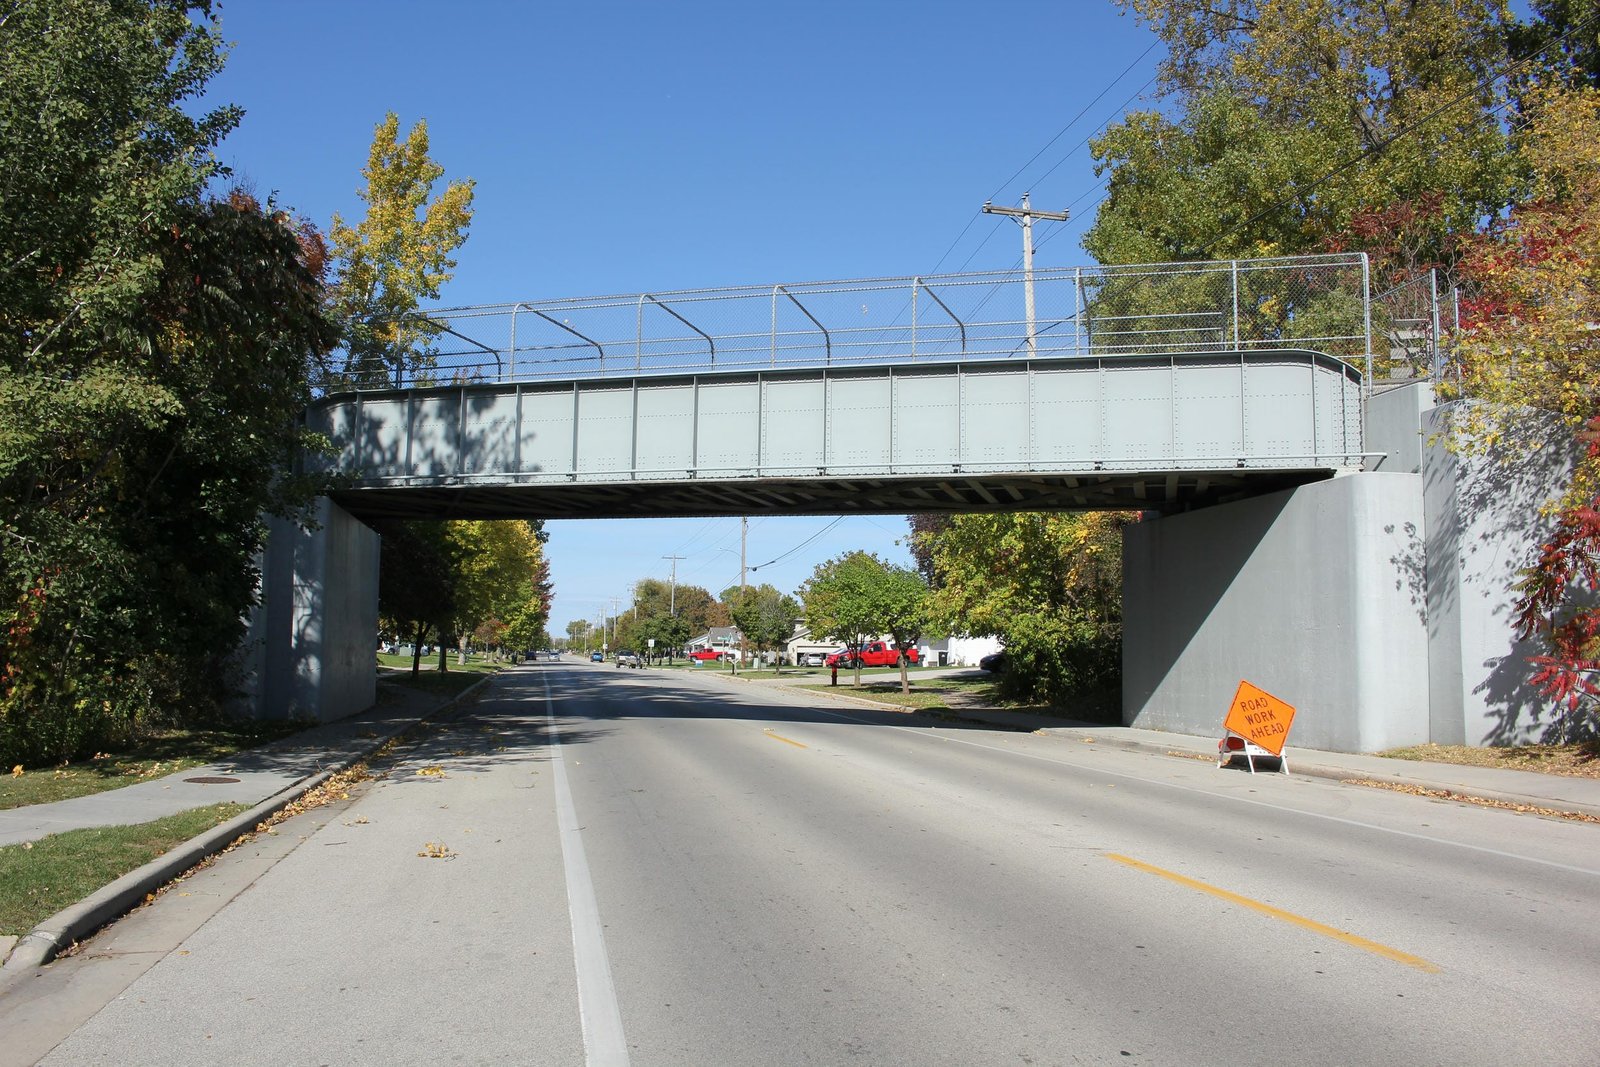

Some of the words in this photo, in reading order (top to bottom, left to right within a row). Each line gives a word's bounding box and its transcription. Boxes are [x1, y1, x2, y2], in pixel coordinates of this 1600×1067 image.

[1240, 697, 1268, 712] ROAD
[1245, 710, 1276, 725] WORK
[1251, 722, 1284, 739] AHEAD
